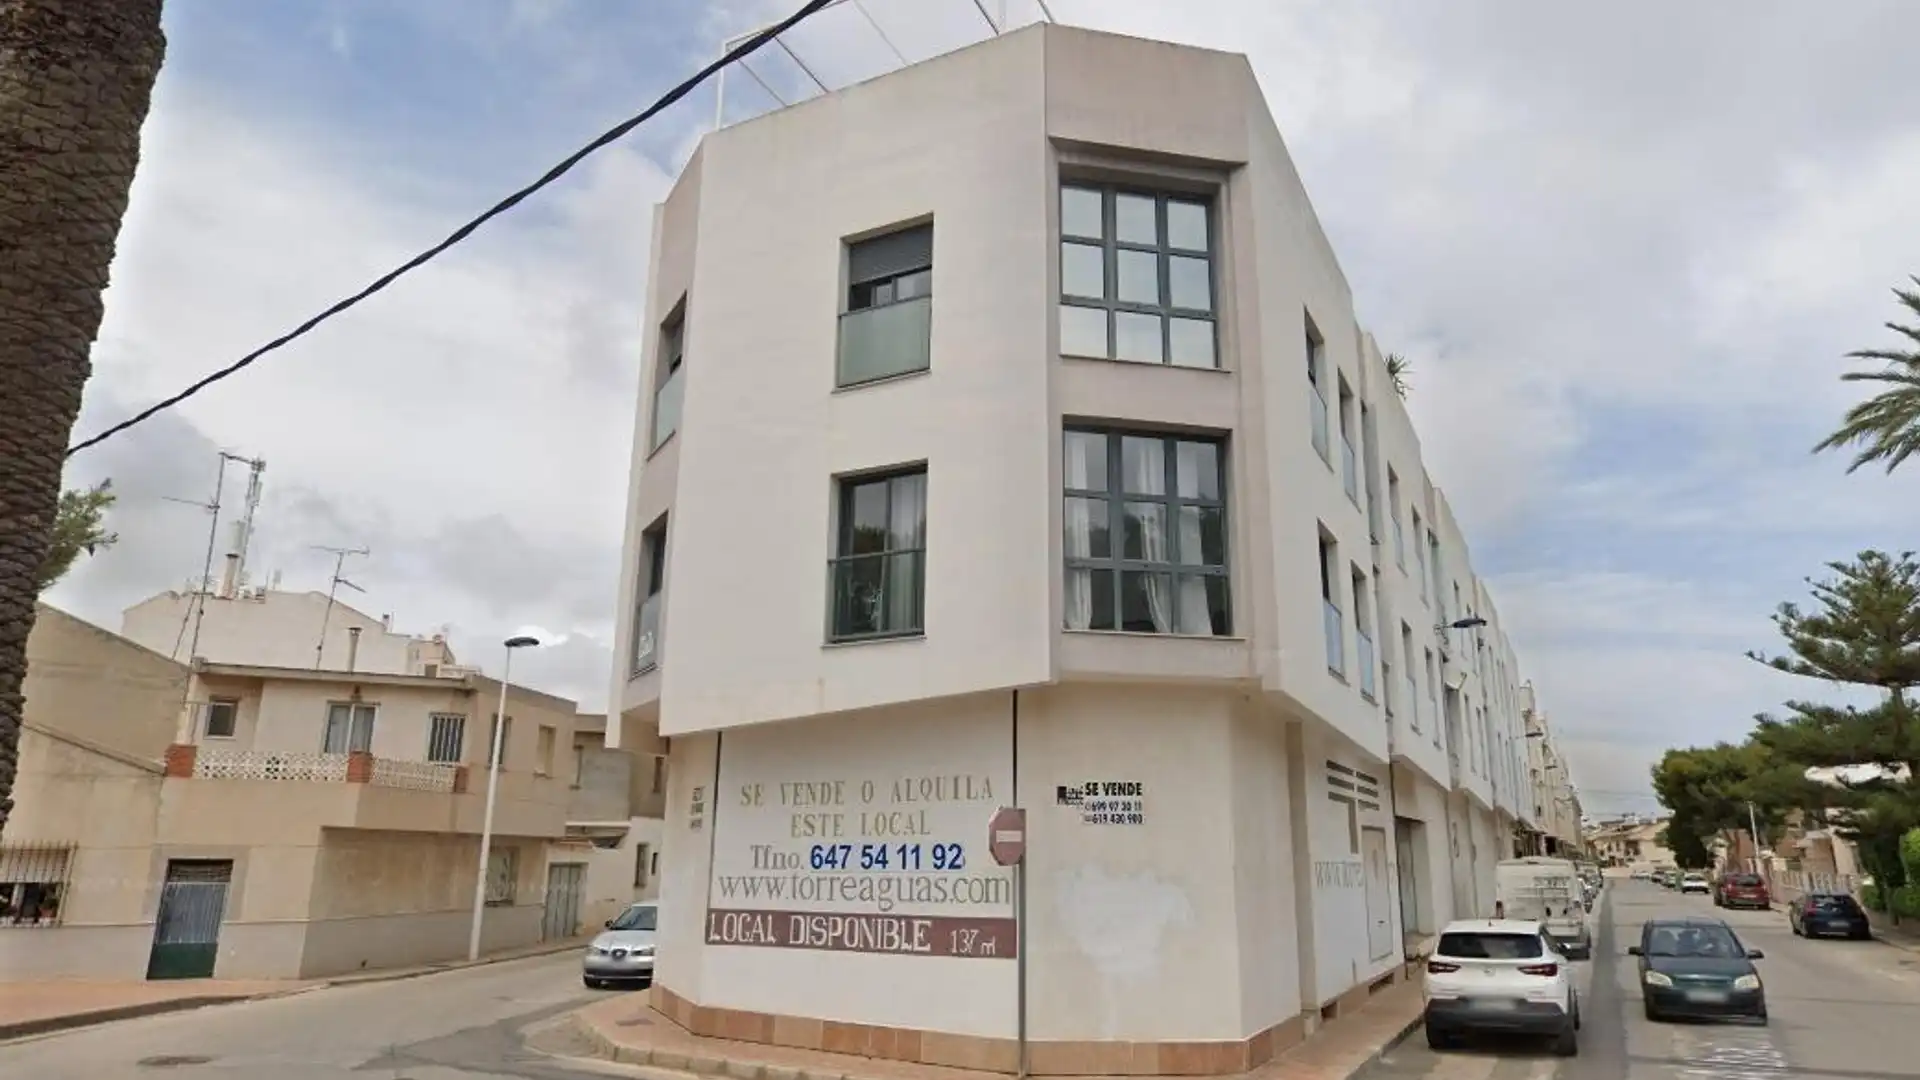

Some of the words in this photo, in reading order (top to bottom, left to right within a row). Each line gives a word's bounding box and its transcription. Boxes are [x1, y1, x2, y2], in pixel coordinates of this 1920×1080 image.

[740, 783, 764, 806] SE
[780, 780, 845, 806] VENDE
[861, 780, 874, 803] O
[890, 776, 994, 803] ALQUILA
[1085, 782, 1099, 796] SE
[1102, 782, 1143, 797] VENDE
[791, 813, 844, 838] ESTE
[861, 810, 931, 837] LOCAL
[810, 843, 852, 870] 647
[860, 843, 888, 870] 54
[896, 843, 920, 870] 11
[932, 842, 963, 870] 92
[718, 873, 1010, 912] www.torreaguas.com
[708, 912, 777, 944] LOCAL
[789, 915, 932, 952] DISPONIBLE
[950, 928, 979, 954] 137
